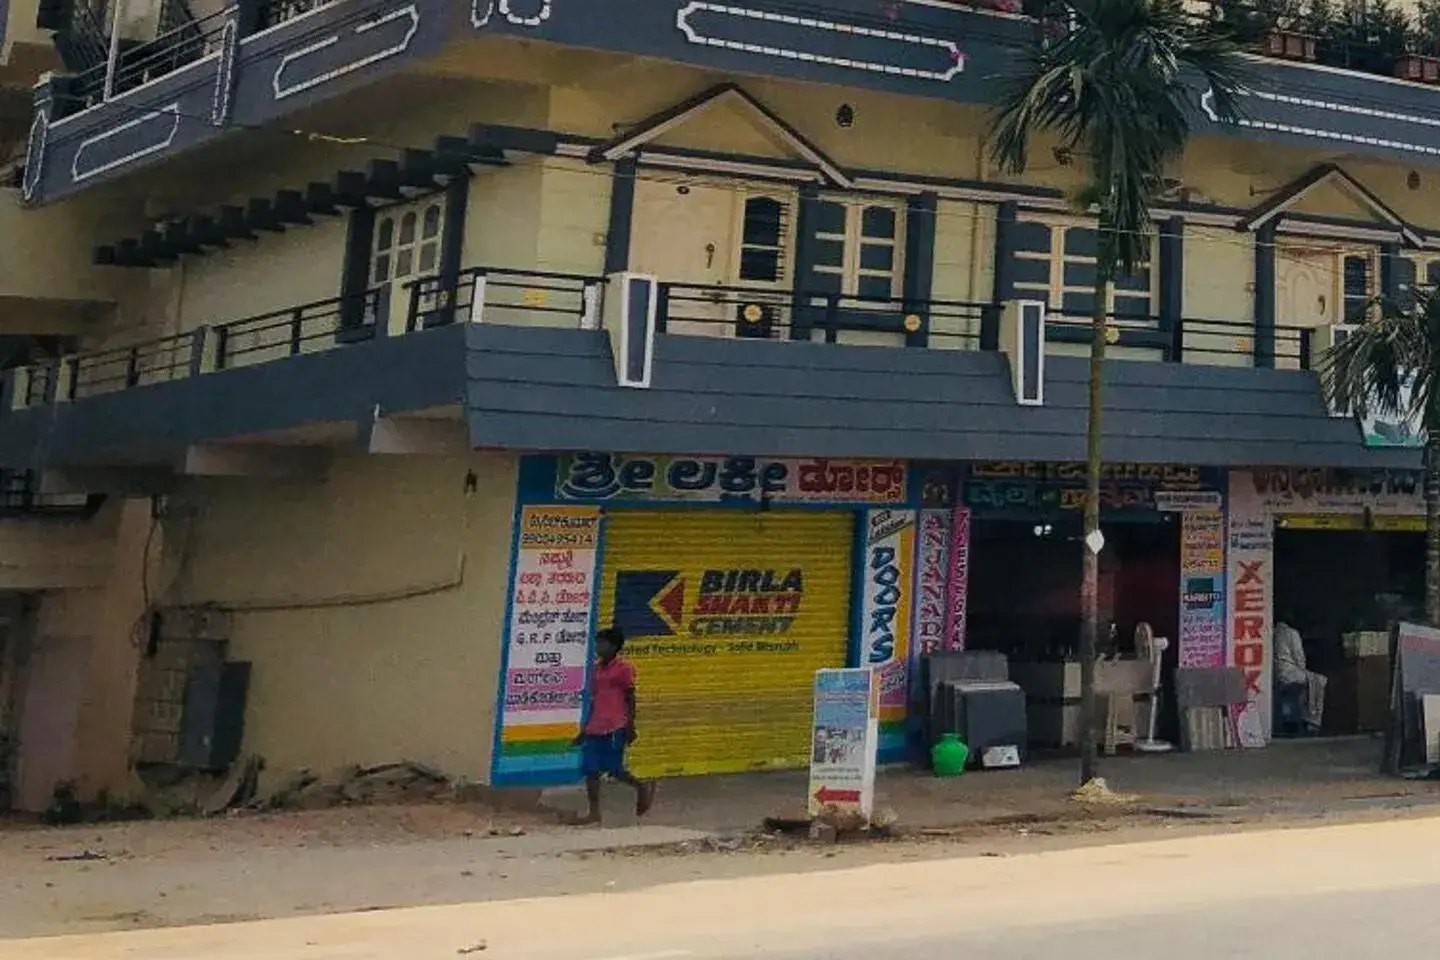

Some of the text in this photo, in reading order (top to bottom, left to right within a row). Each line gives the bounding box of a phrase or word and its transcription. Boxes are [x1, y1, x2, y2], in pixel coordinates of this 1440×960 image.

[701, 570, 802, 593] BIRLA
[695, 593, 801, 615] SHAKTI
[869, 547, 901, 663] DOORS
[689, 616, 795, 637] CEMENT
[1234, 560, 1264, 696] XEROX
